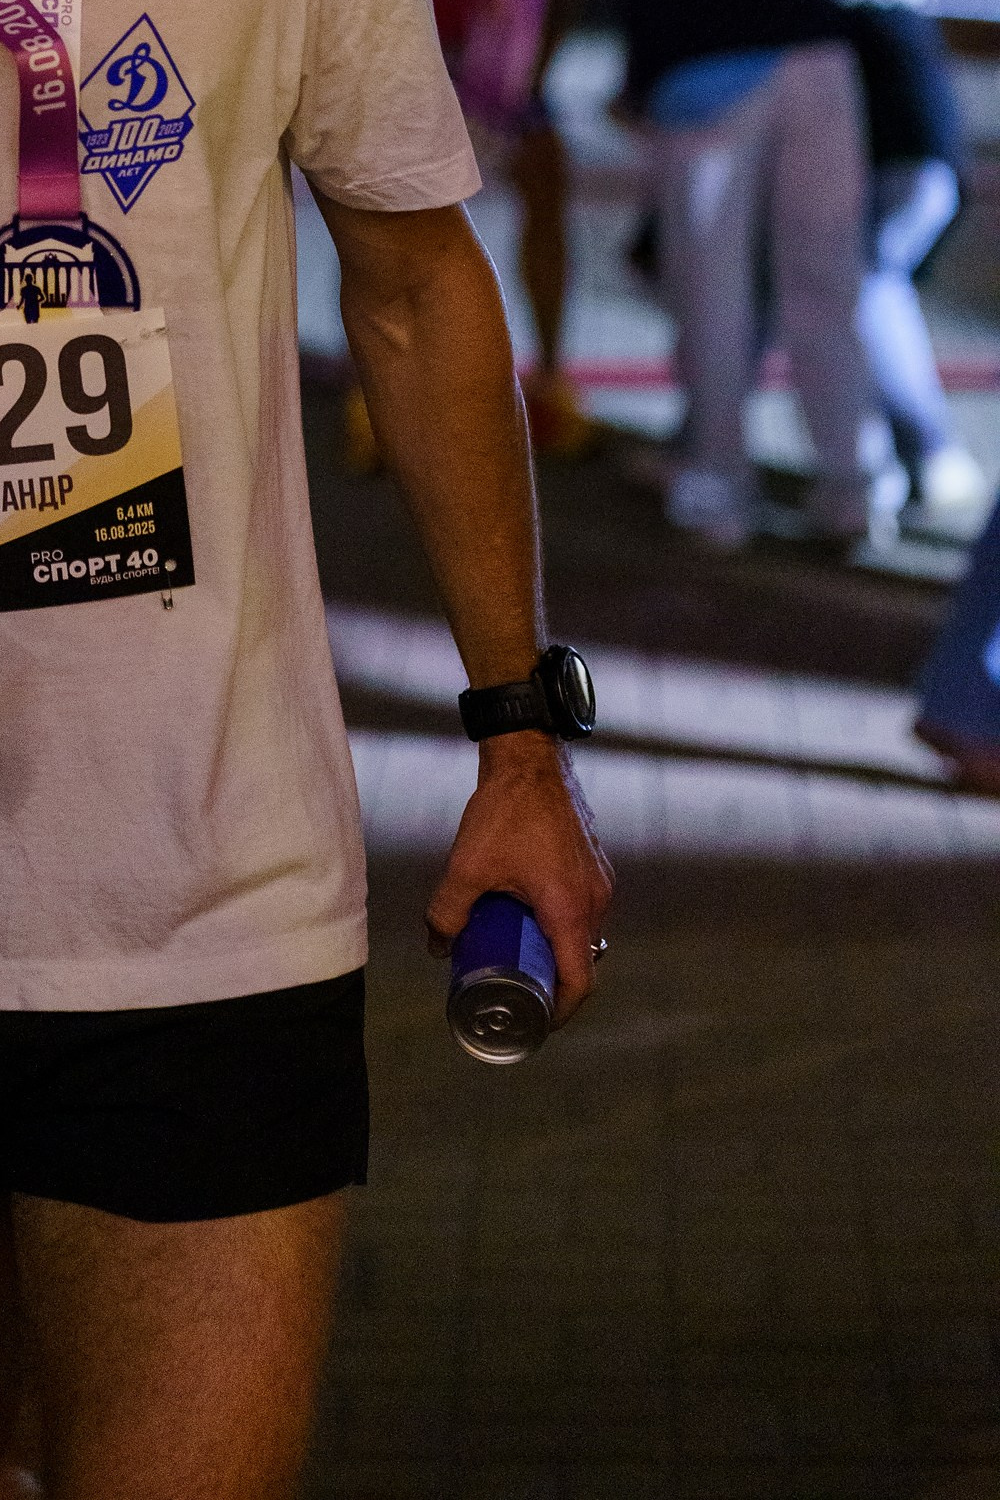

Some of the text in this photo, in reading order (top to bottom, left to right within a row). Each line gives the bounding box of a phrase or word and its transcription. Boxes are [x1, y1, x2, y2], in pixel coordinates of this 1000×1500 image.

[108, 116, 162, 153] 100
[158, 121, 185, 137] 2023
[84, 144, 180, 171] ДИНАМО
[117, 166, 142, 179] ЛЕТ
[136, 502, 154, 517] КМ
[94, 520, 156, 542] 16.08.2025
[31, 549, 64, 565] PRO
[33, 548, 159, 583] СПОРТ 40
[90, 566, 160, 585] БУДЬ В СПОРТЕ!
